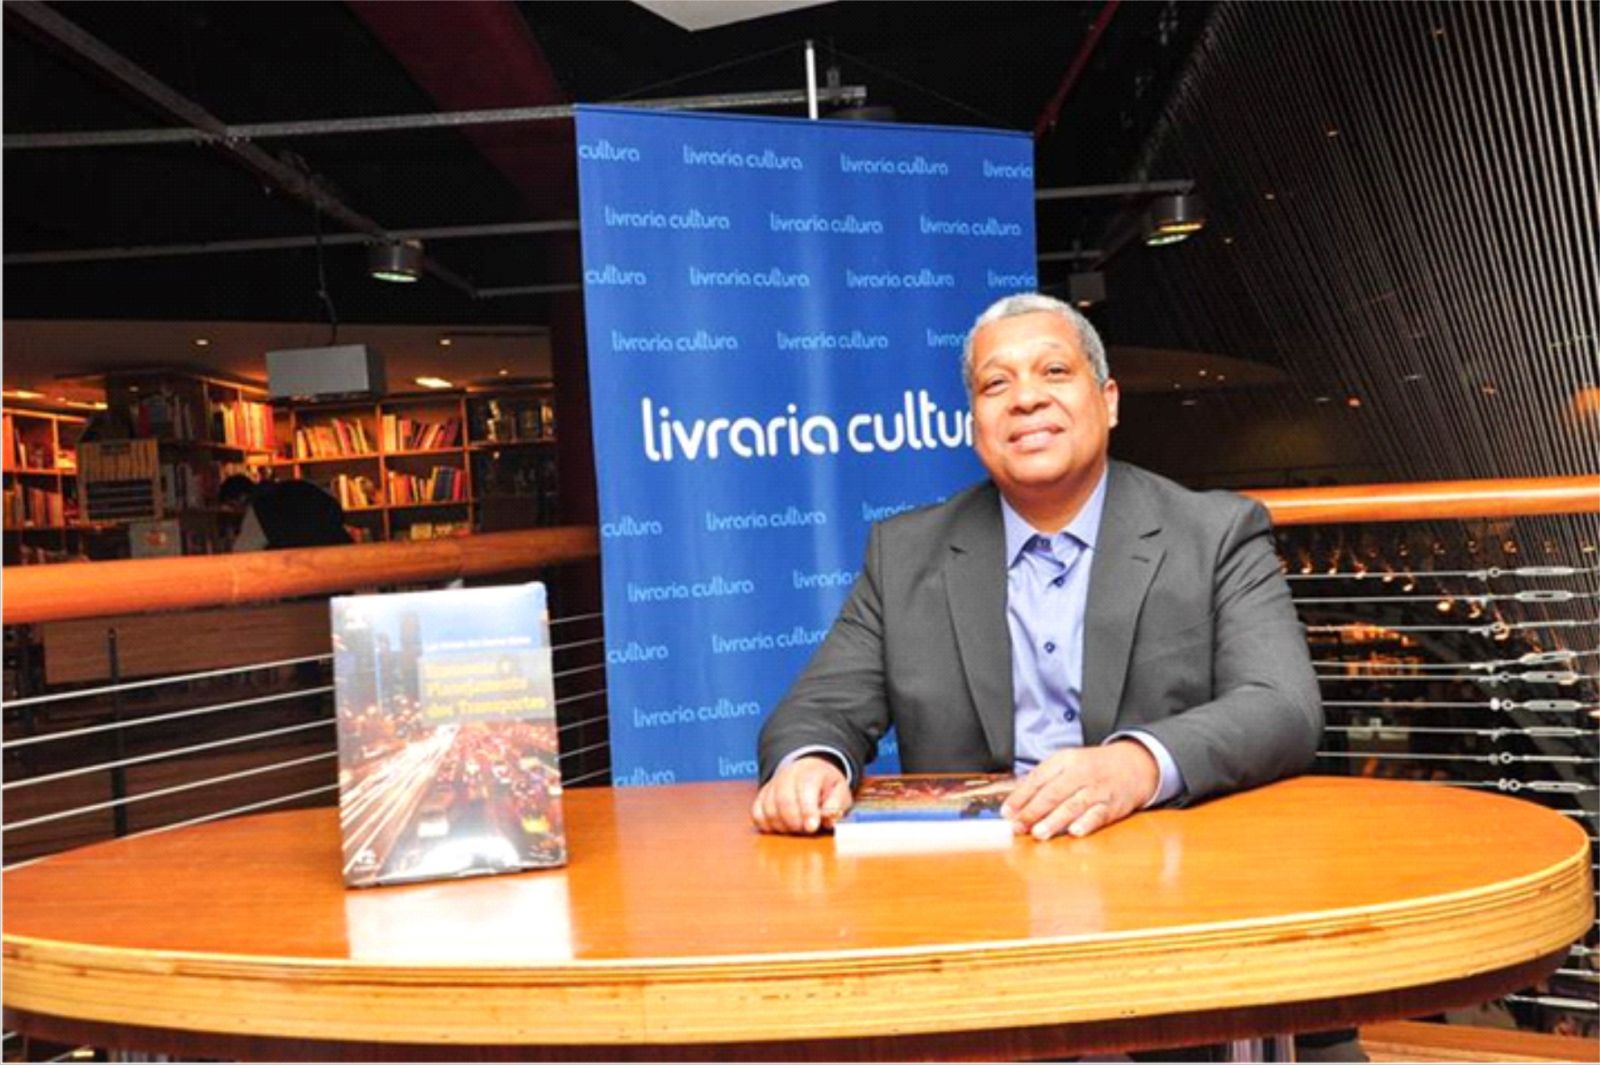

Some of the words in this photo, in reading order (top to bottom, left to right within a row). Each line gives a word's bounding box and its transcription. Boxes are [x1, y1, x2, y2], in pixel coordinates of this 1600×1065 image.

[579, 140, 640, 162] cultura
[683, 144, 743, 167] livraria
[746, 149, 803, 170] cultura
[840, 153, 894, 174] livraria
[897, 155, 949, 176] cultura
[983, 159, 1033, 178] livraria
[605, 205, 666, 228] livraria
[669, 209, 730, 229] cultura
[770, 212, 829, 232] livraria
[831, 214, 883, 234] cultura
[920, 215, 969, 234] livraria
[972, 218, 1021, 236] cultura
[585, 264, 646, 285] cultura
[689, 266, 750, 286] livraria
[753, 267, 810, 287] cultura
[847, 269, 901, 288] livraria
[903, 268, 955, 288] cultura
[987, 269, 1036, 288] livraria
[612, 329, 672, 352] livraria
[676, 330, 738, 352] cultura
[777, 330, 836, 350] livraria
[838, 330, 888, 350] cultura
[641, 397, 840, 462] livraria
[847, 389, 974, 453] cultur
[602, 515, 663, 538] cultura
[705, 511, 767, 531] livraria
[770, 505, 827, 527] cultura
[627, 581, 689, 603] livraria
[691, 576, 754, 598] cultura
[793, 569, 852, 589] livraria
[712, 634, 774, 653] livraria
[776, 626, 829, 648] cultur
[607, 641, 669, 664] cultura
[634, 706, 695, 728] livraria
[697, 699, 760, 721] cultura
[718, 756, 758, 777] livra
